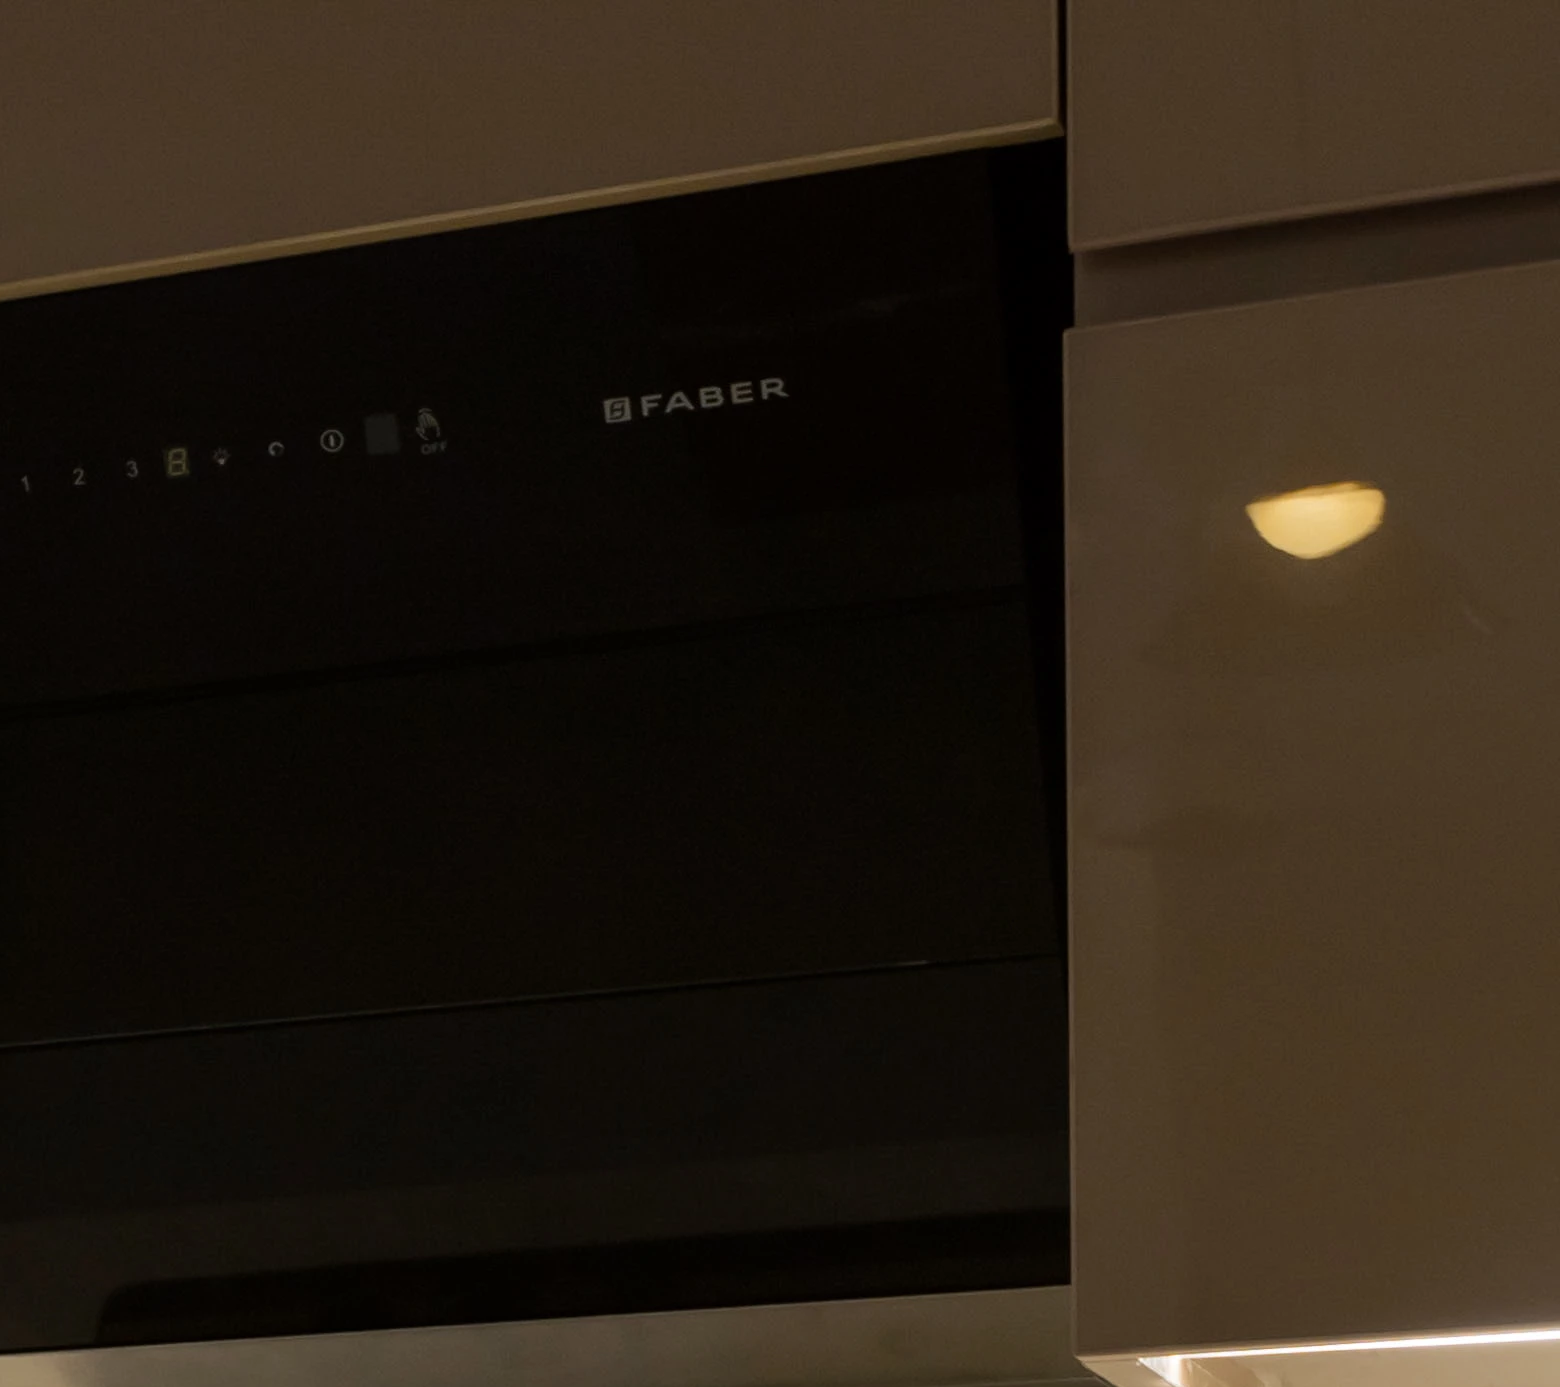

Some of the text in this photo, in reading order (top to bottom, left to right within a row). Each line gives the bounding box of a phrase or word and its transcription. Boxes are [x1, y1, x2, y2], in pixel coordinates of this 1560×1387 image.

[640, 377, 790, 417] FABER
[20, 474, 31, 493] 1
[72, 467, 87, 486] 2
[125, 460, 139, 478] 3
